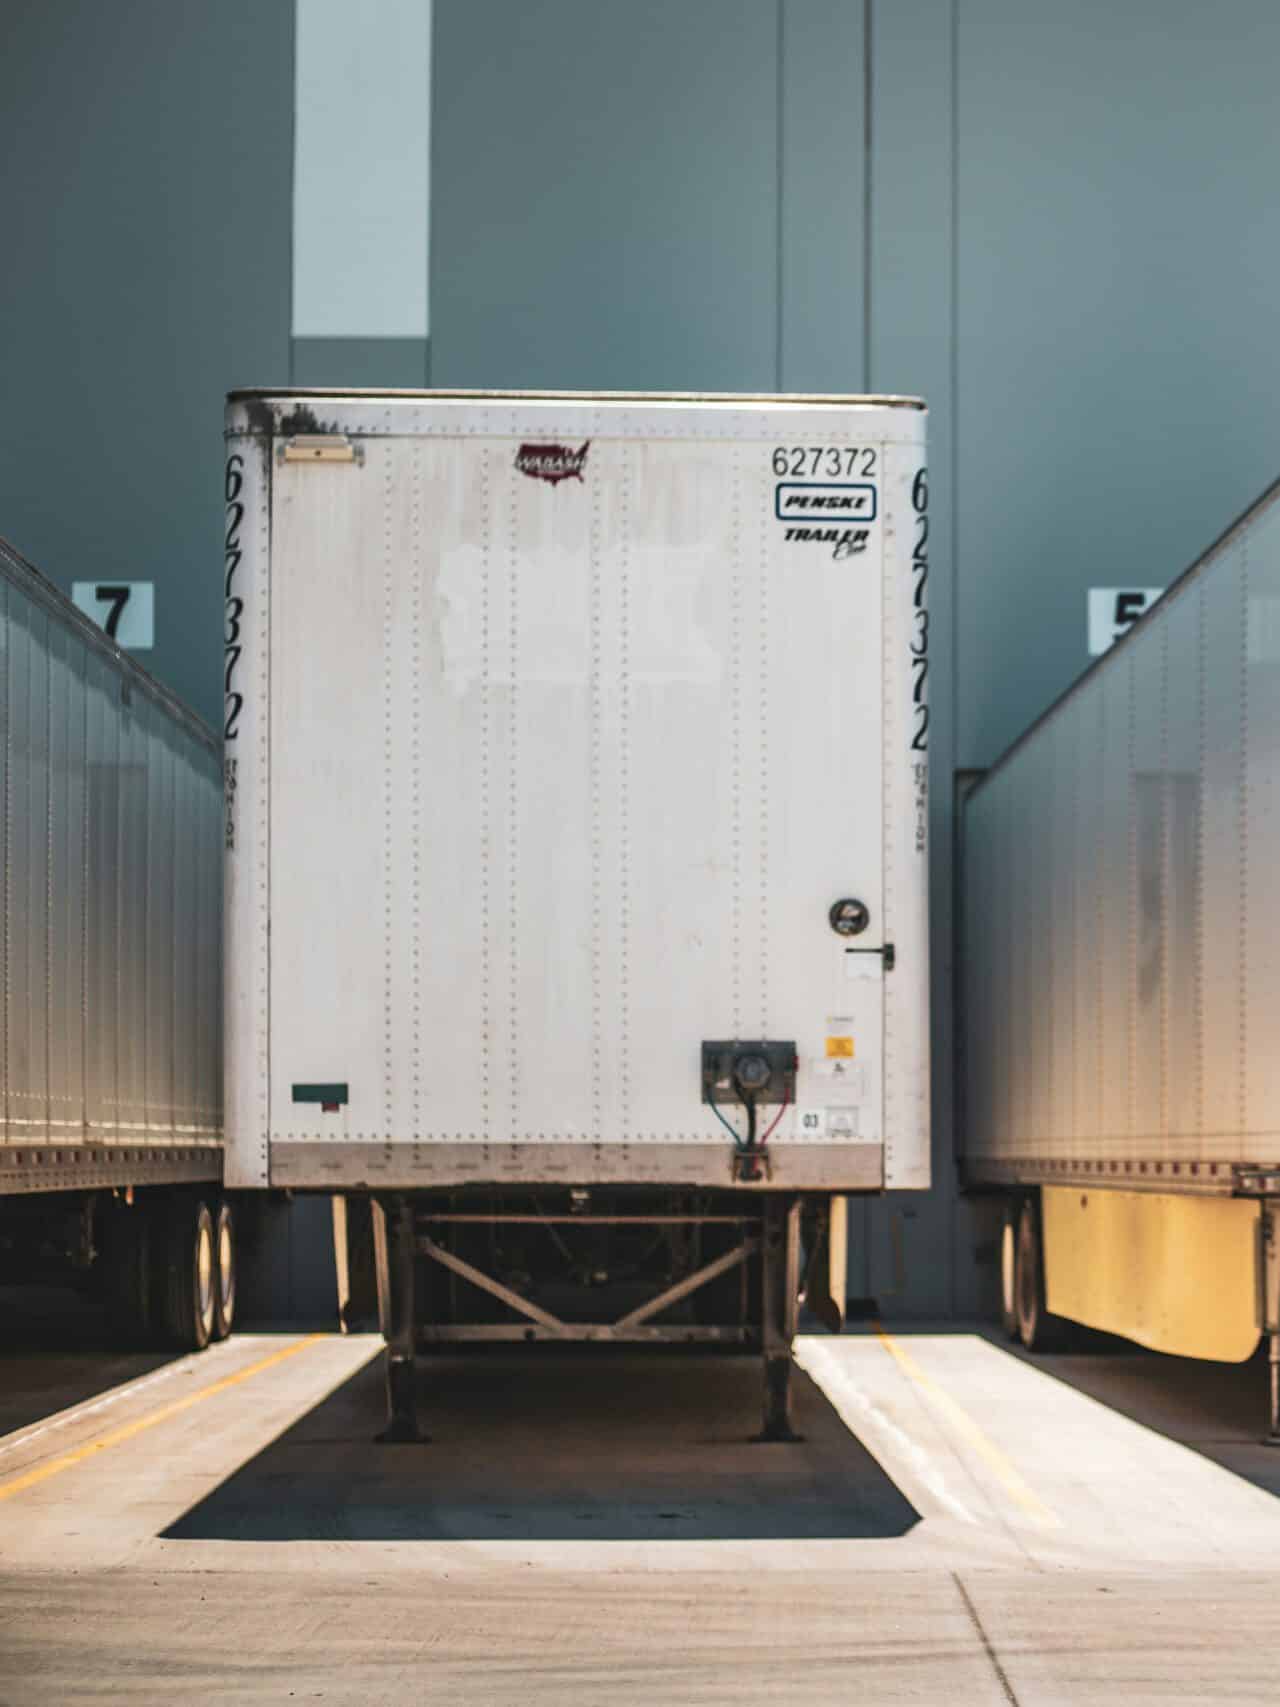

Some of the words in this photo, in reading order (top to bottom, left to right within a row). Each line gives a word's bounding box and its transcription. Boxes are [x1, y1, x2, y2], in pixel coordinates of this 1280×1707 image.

[772, 446, 877, 477] 627372
[784, 496, 867, 509] PENSKE
[783, 528, 870, 542] TRAILER
[96, 587, 130, 640] 7
[224, 454, 244, 740] 627372
[911, 466, 929, 751] 627372
[1114, 592, 1146, 642] 5
